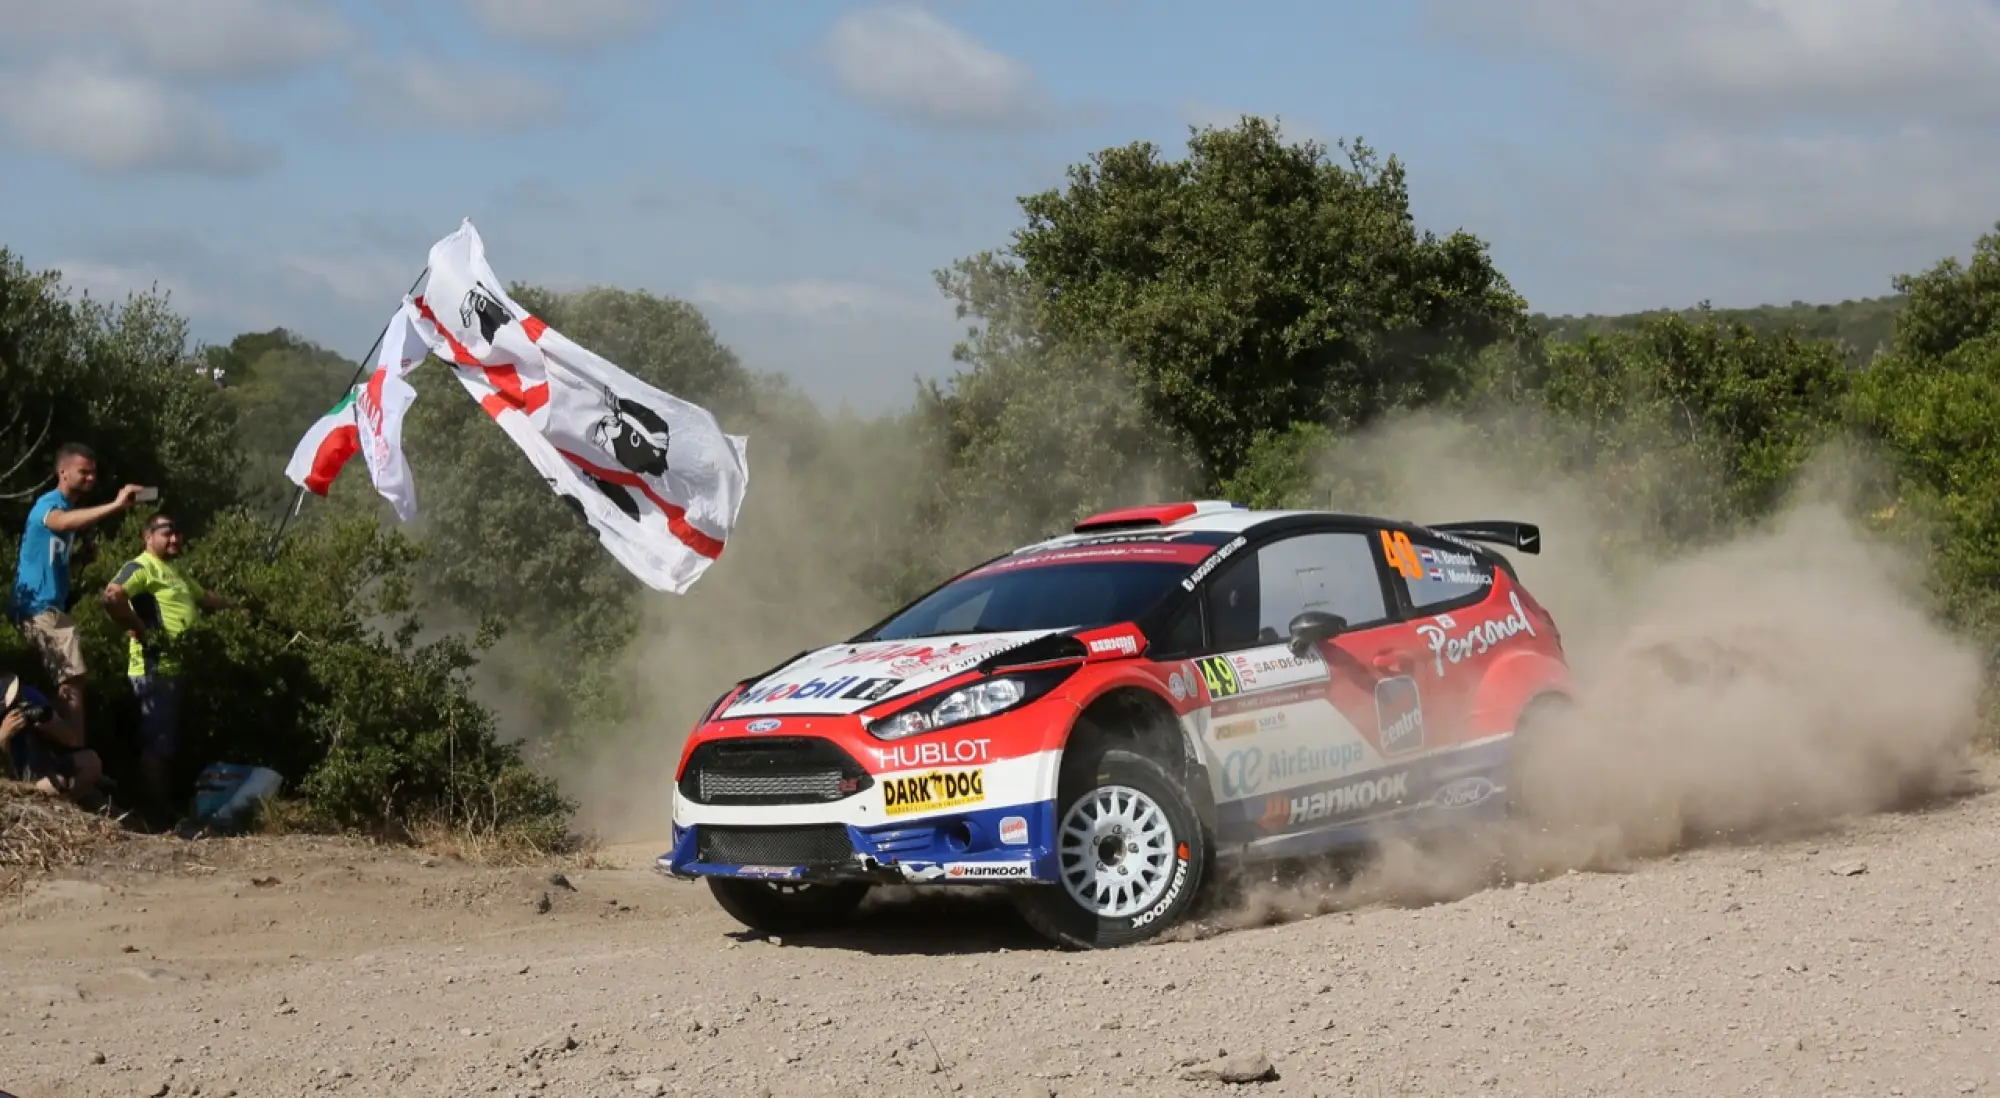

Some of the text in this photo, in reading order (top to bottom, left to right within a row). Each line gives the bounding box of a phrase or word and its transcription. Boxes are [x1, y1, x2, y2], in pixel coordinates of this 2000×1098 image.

[1380, 530, 1424, 580] 49
[1416, 591, 1537, 677] Personal
[1202, 656, 1239, 697] 49
[1381, 708, 1422, 748] centro
[880, 739, 991, 769] HUBLOT
[884, 779, 931, 806] DARK
[945, 770, 984, 799] DOG
